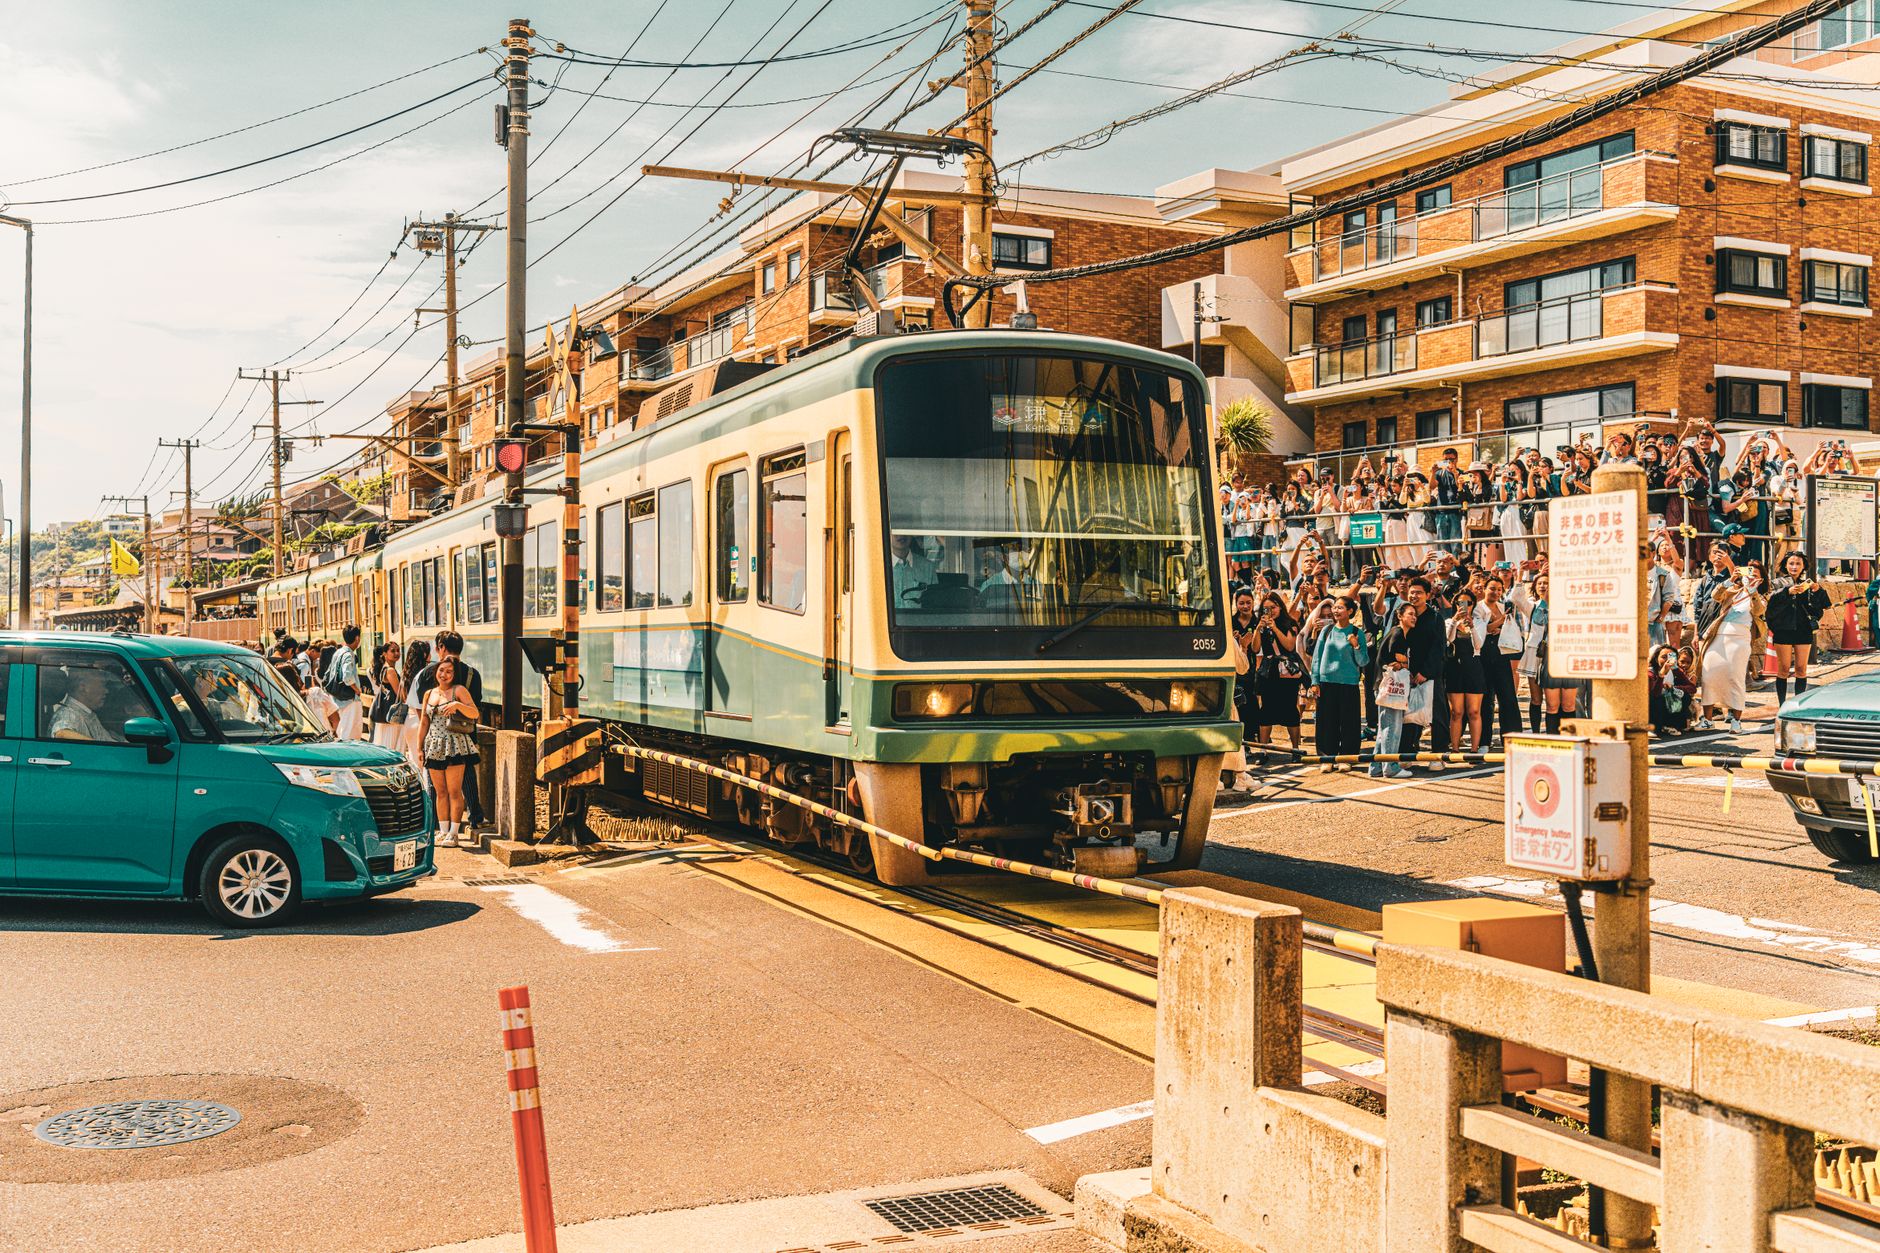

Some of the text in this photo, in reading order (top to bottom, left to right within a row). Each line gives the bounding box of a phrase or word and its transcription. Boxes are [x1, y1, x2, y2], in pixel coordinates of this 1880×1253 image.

[1024, 399, 1073, 424] 鎌倉
[1560, 512, 1623, 530] 非常の際は
[1559, 529, 1624, 547] このボタンを
[1193, 639, 1216, 650] 2052
[1515, 824, 1571, 839] Emergency button
[1514, 837, 1573, 862] 非常ボタン
